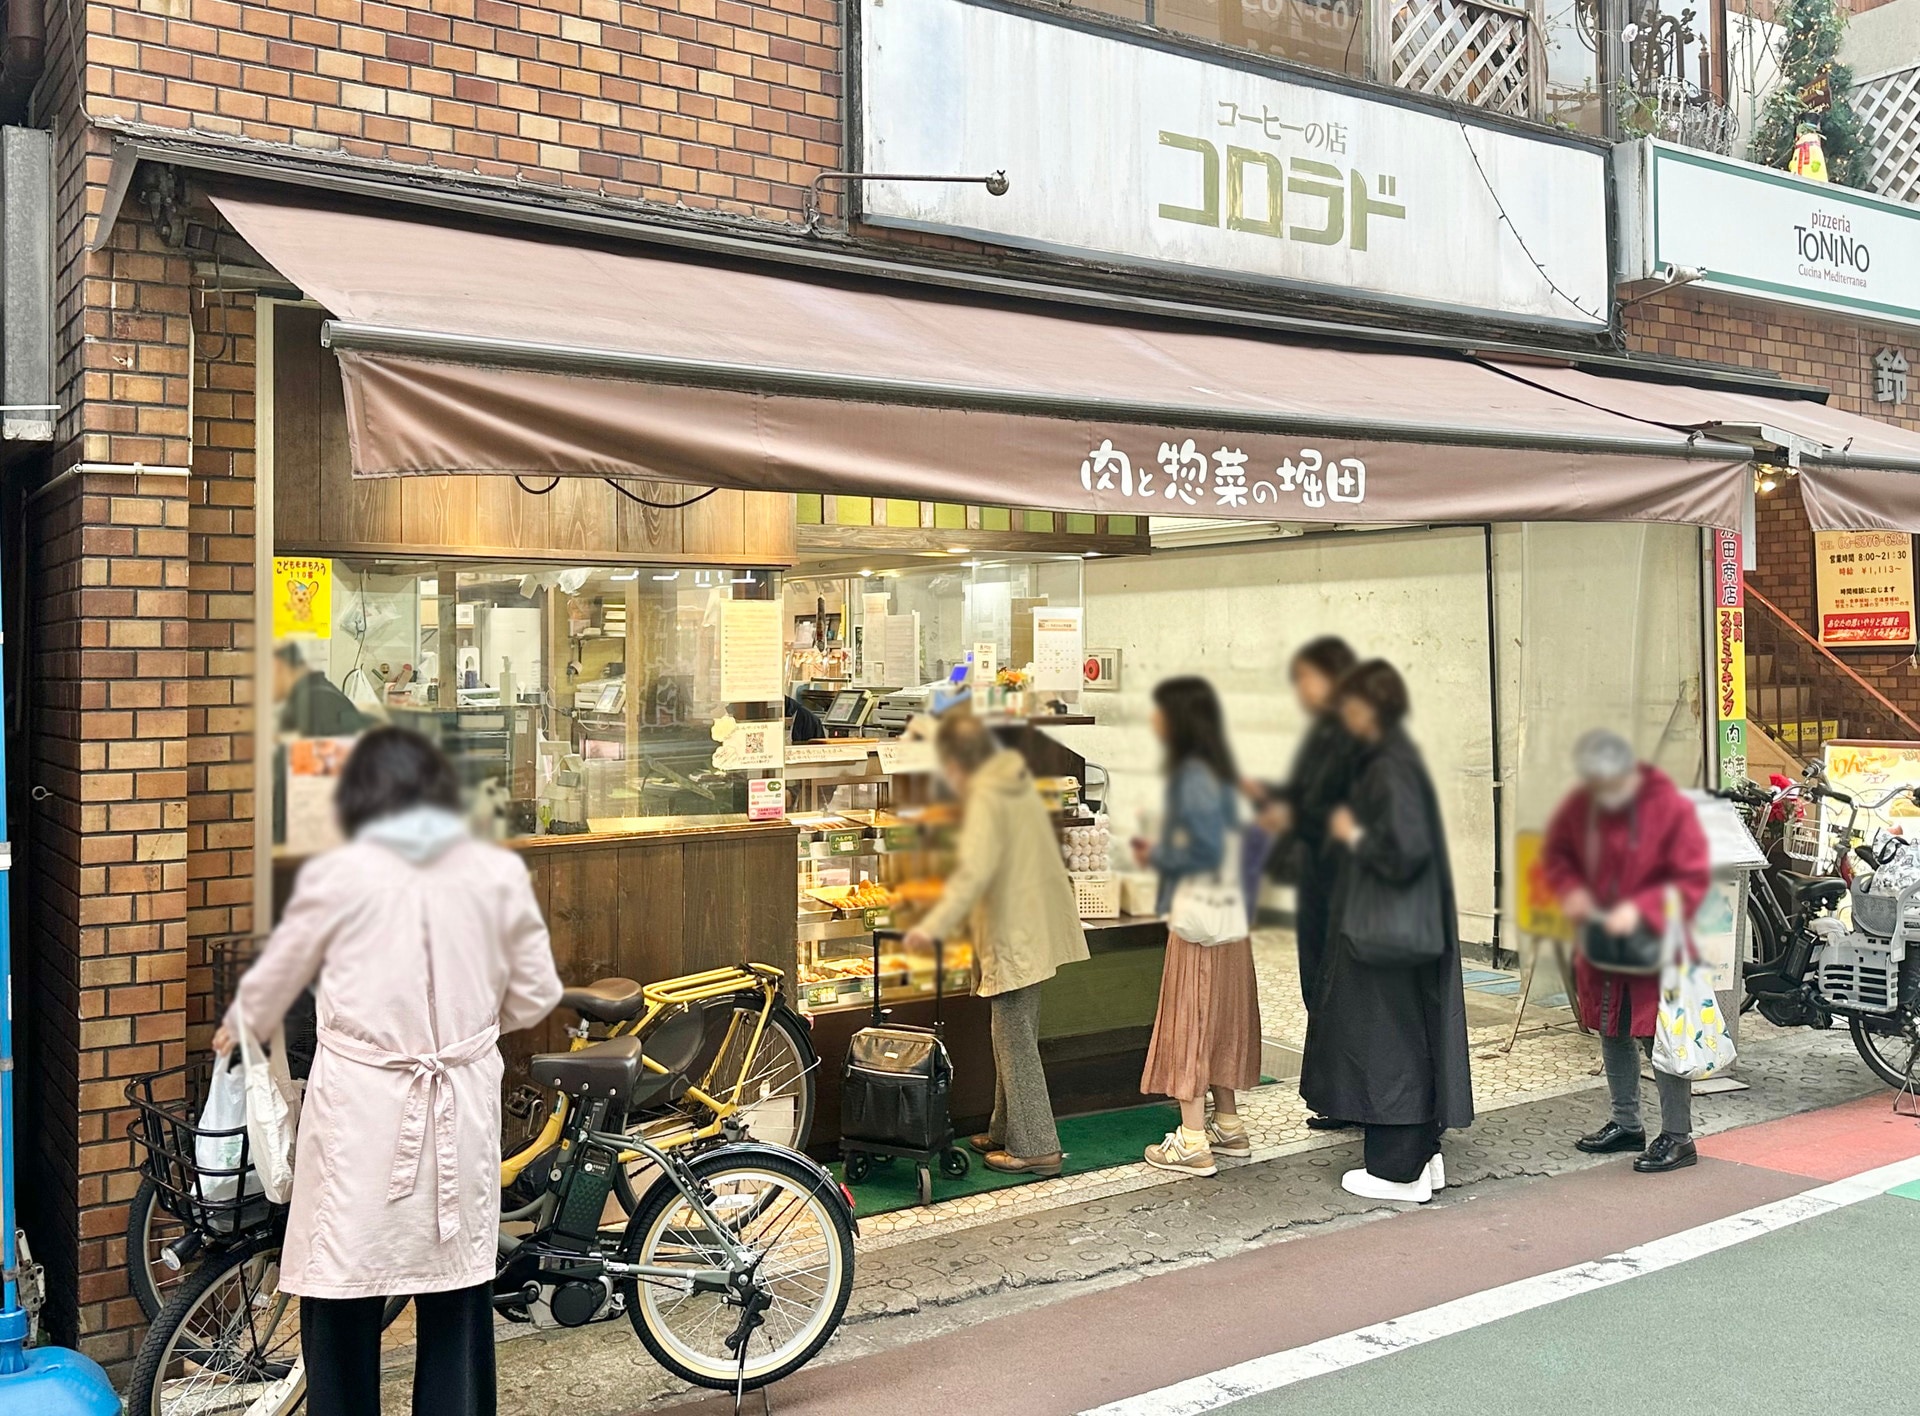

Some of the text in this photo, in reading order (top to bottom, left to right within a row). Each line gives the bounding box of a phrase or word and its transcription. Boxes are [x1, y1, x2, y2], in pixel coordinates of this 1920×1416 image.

[1217, 99, 1349, 155] コーヒーの店
[1158, 129, 1406, 252] コロラド
[1811, 209, 1851, 233] pizzeria
[1793, 225, 1870, 273] TONINO
[1798, 264, 1867, 288] Cucina Mediterranea
[1872, 346, 1909, 404] 鈴
[1080, 438, 1367, 508] 肉と惣菜の堀田
[276, 560, 326, 576] こどもをまもろう
[1829, 553, 1855, 564] 営業時間
[1840, 586, 1896, 596] 時間相談に応じます
[1720, 610, 1735, 718] スタミナキング
